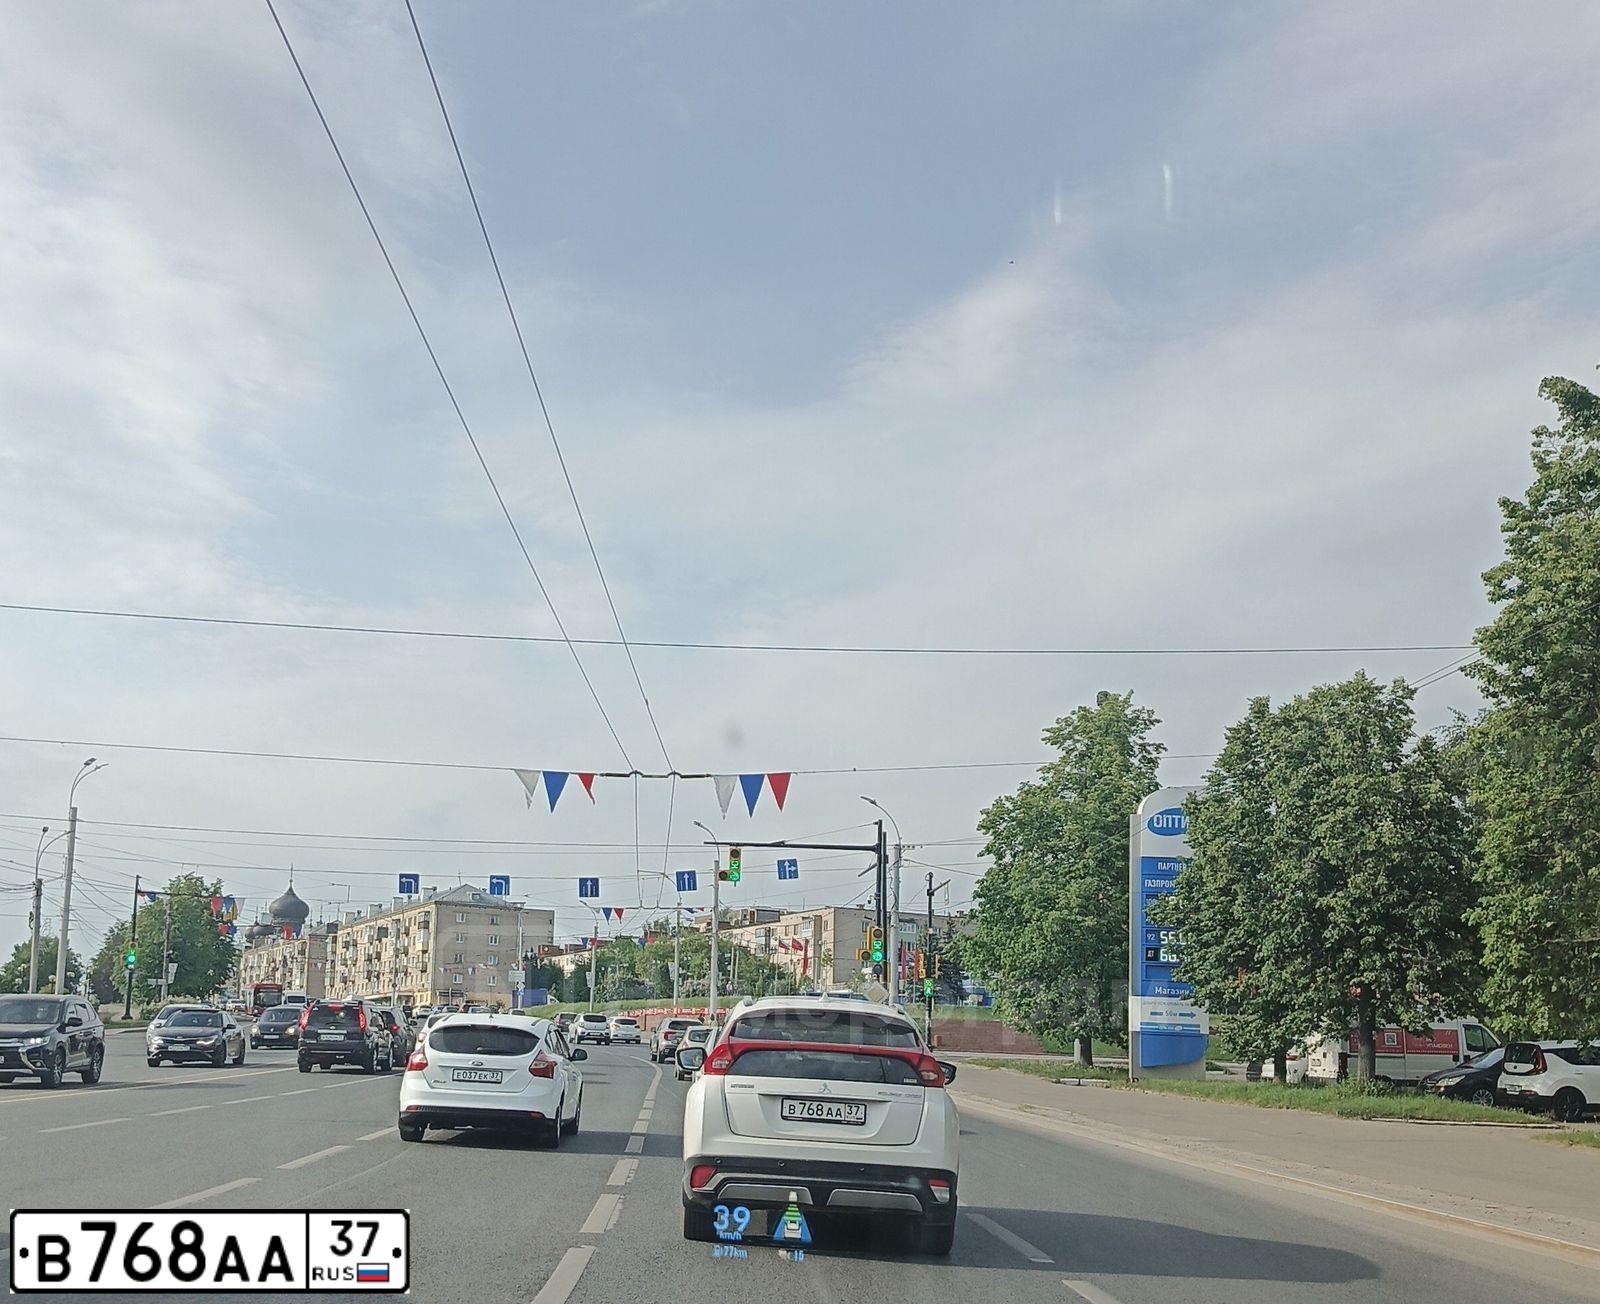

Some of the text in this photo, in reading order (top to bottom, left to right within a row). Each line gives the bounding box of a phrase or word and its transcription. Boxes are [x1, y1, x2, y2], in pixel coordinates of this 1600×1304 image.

[788, 1102, 861, 1119] В768АА 37
[713, 1204, 751, 1232] 39
[719, 1230, 742, 1240] km/h
